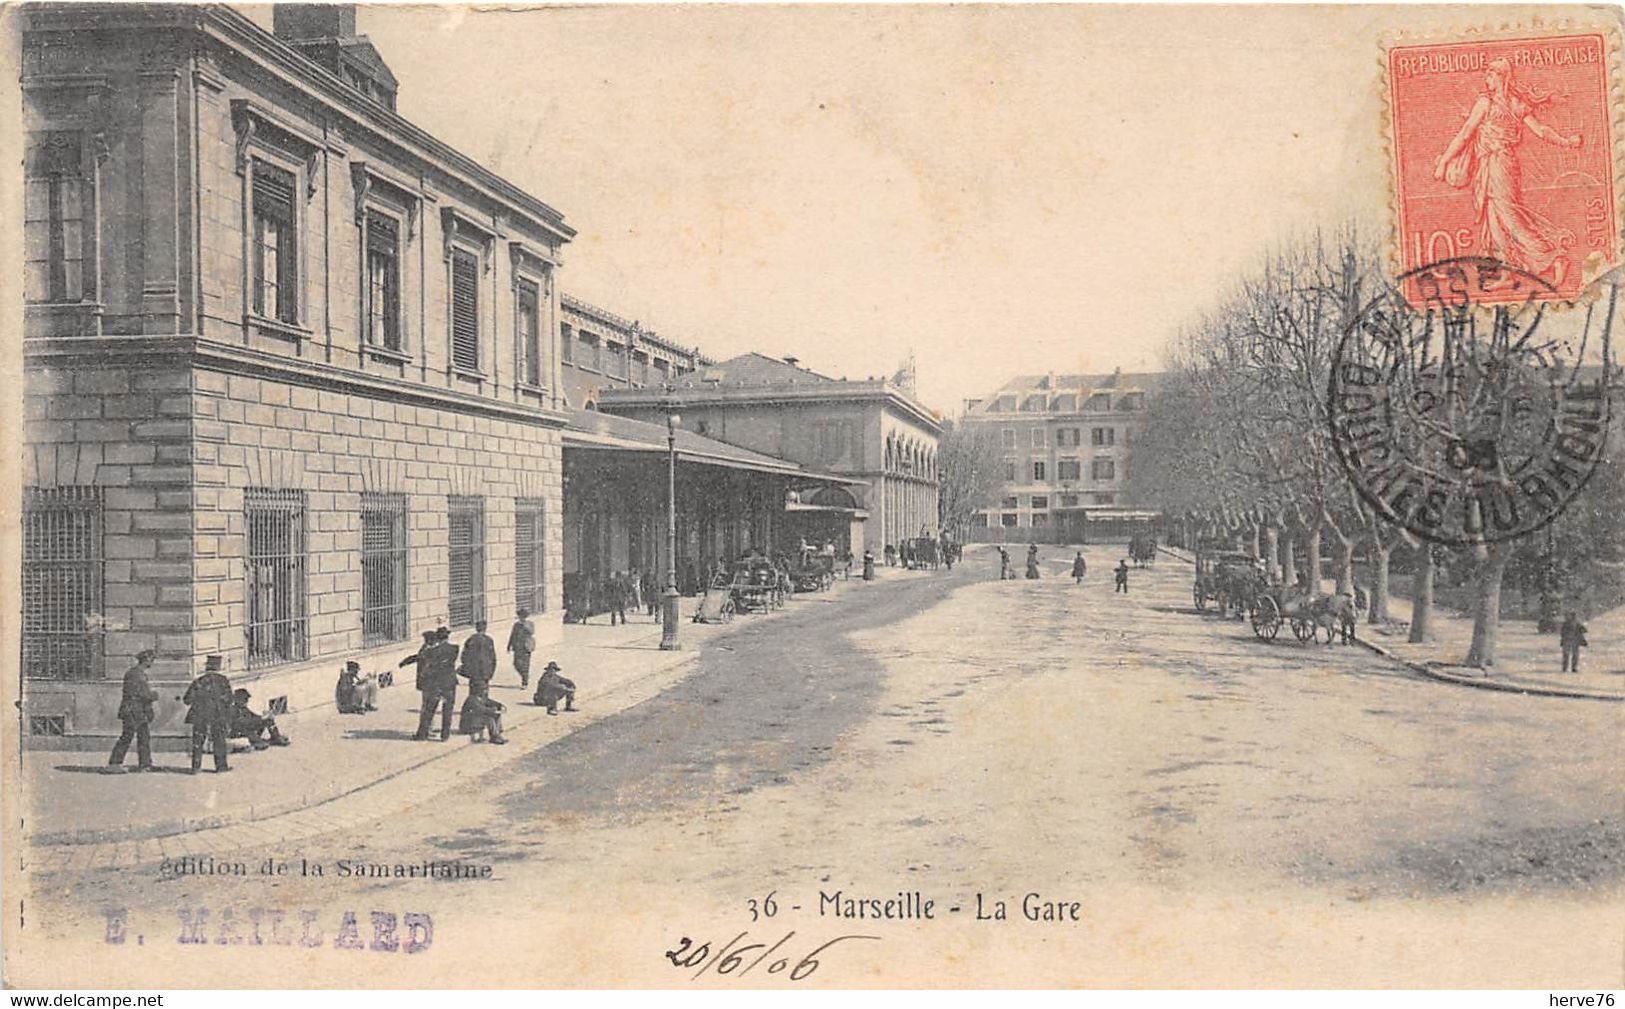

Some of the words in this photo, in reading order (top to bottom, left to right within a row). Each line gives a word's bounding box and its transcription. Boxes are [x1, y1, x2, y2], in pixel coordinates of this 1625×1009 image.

[160, 857, 248, 877] édition
[260, 857, 290, 877] de
[301, 858, 325, 877] la
[337, 859, 495, 880] Samaritaine
[748, 891, 778, 922] 36
[819, 891, 935, 919] Marseille
[976, 893, 1007, 920] La
[1022, 892, 1081, 921] Gare
[177, 907, 434, 954] MAILLARD
